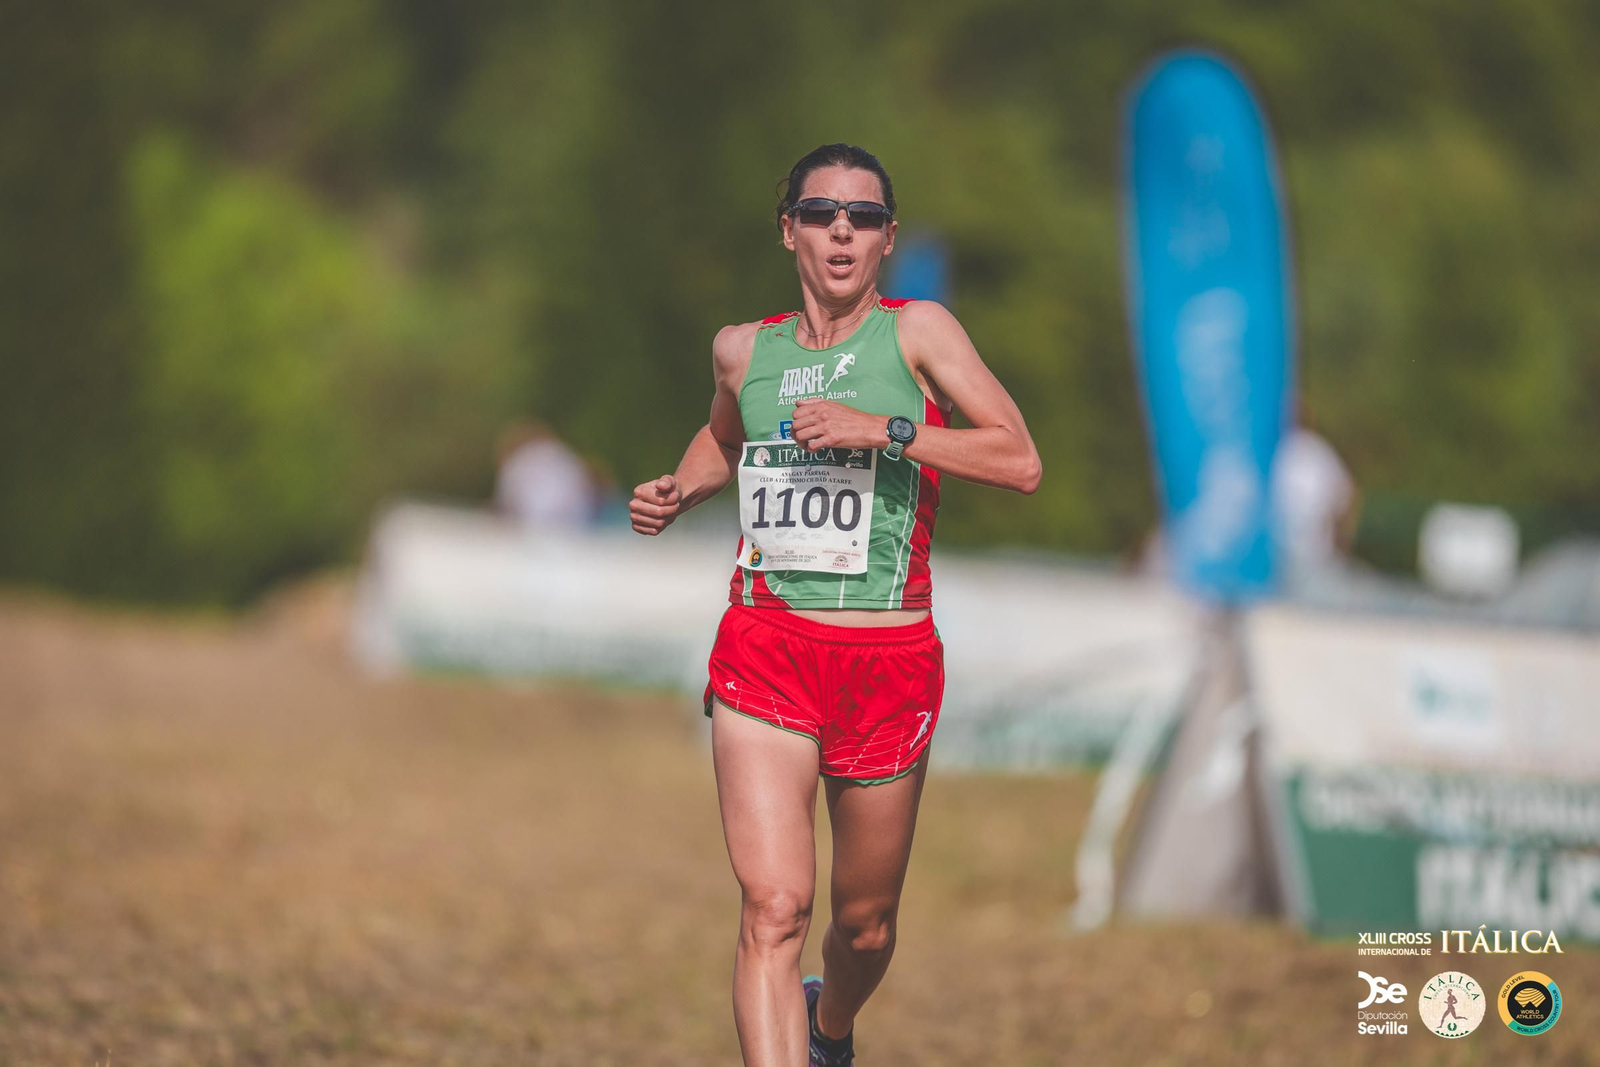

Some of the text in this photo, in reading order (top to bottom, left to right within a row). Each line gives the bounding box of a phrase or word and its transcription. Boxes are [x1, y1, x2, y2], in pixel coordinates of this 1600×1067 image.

[778, 364, 825, 397] ATARFE
[826, 389, 857, 400] Atarfe
[778, 445, 836, 462] ITÁLICA
[752, 486, 862, 531] 1100
